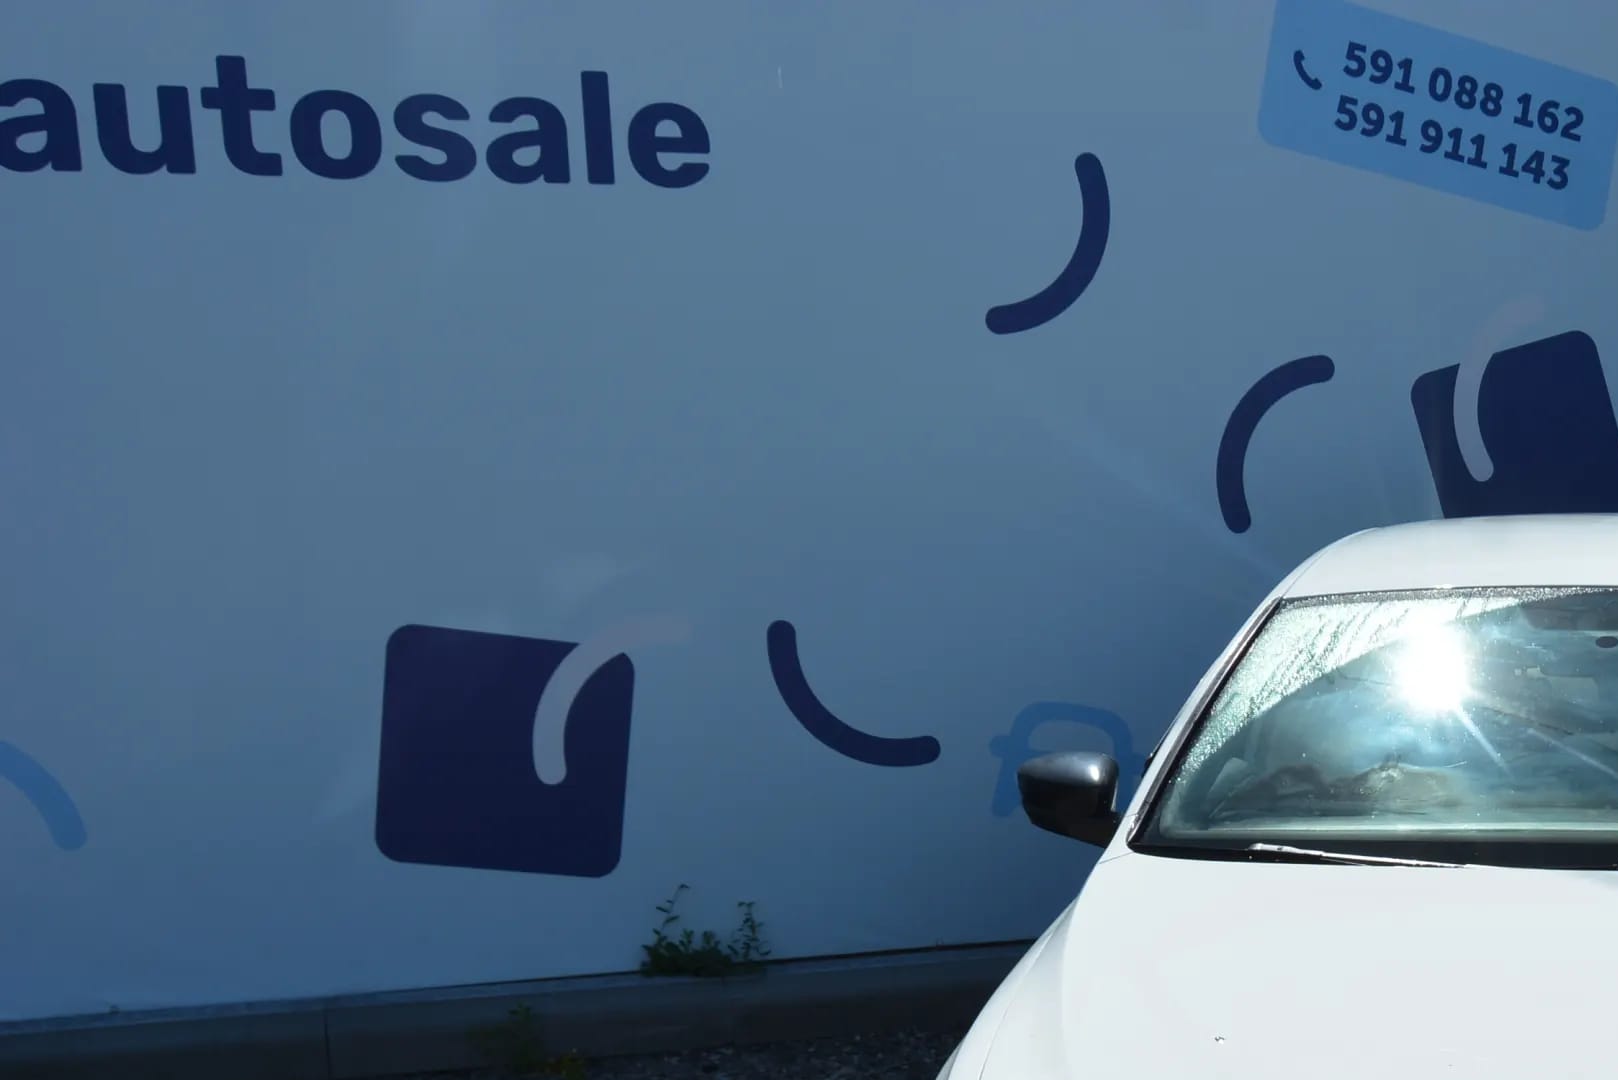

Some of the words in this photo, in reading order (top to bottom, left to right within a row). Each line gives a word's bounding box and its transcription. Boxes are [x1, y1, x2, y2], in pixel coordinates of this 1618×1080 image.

[0, 55, 711, 188] autosale
[1334, 94, 1407, 146] 591
[1420, 119, 1489, 169] 911
[1499, 143, 1571, 190] 143
[1343, 41, 1416, 94] 591
[1428, 67, 1504, 117] 088
[1513, 93, 1585, 142] 162
